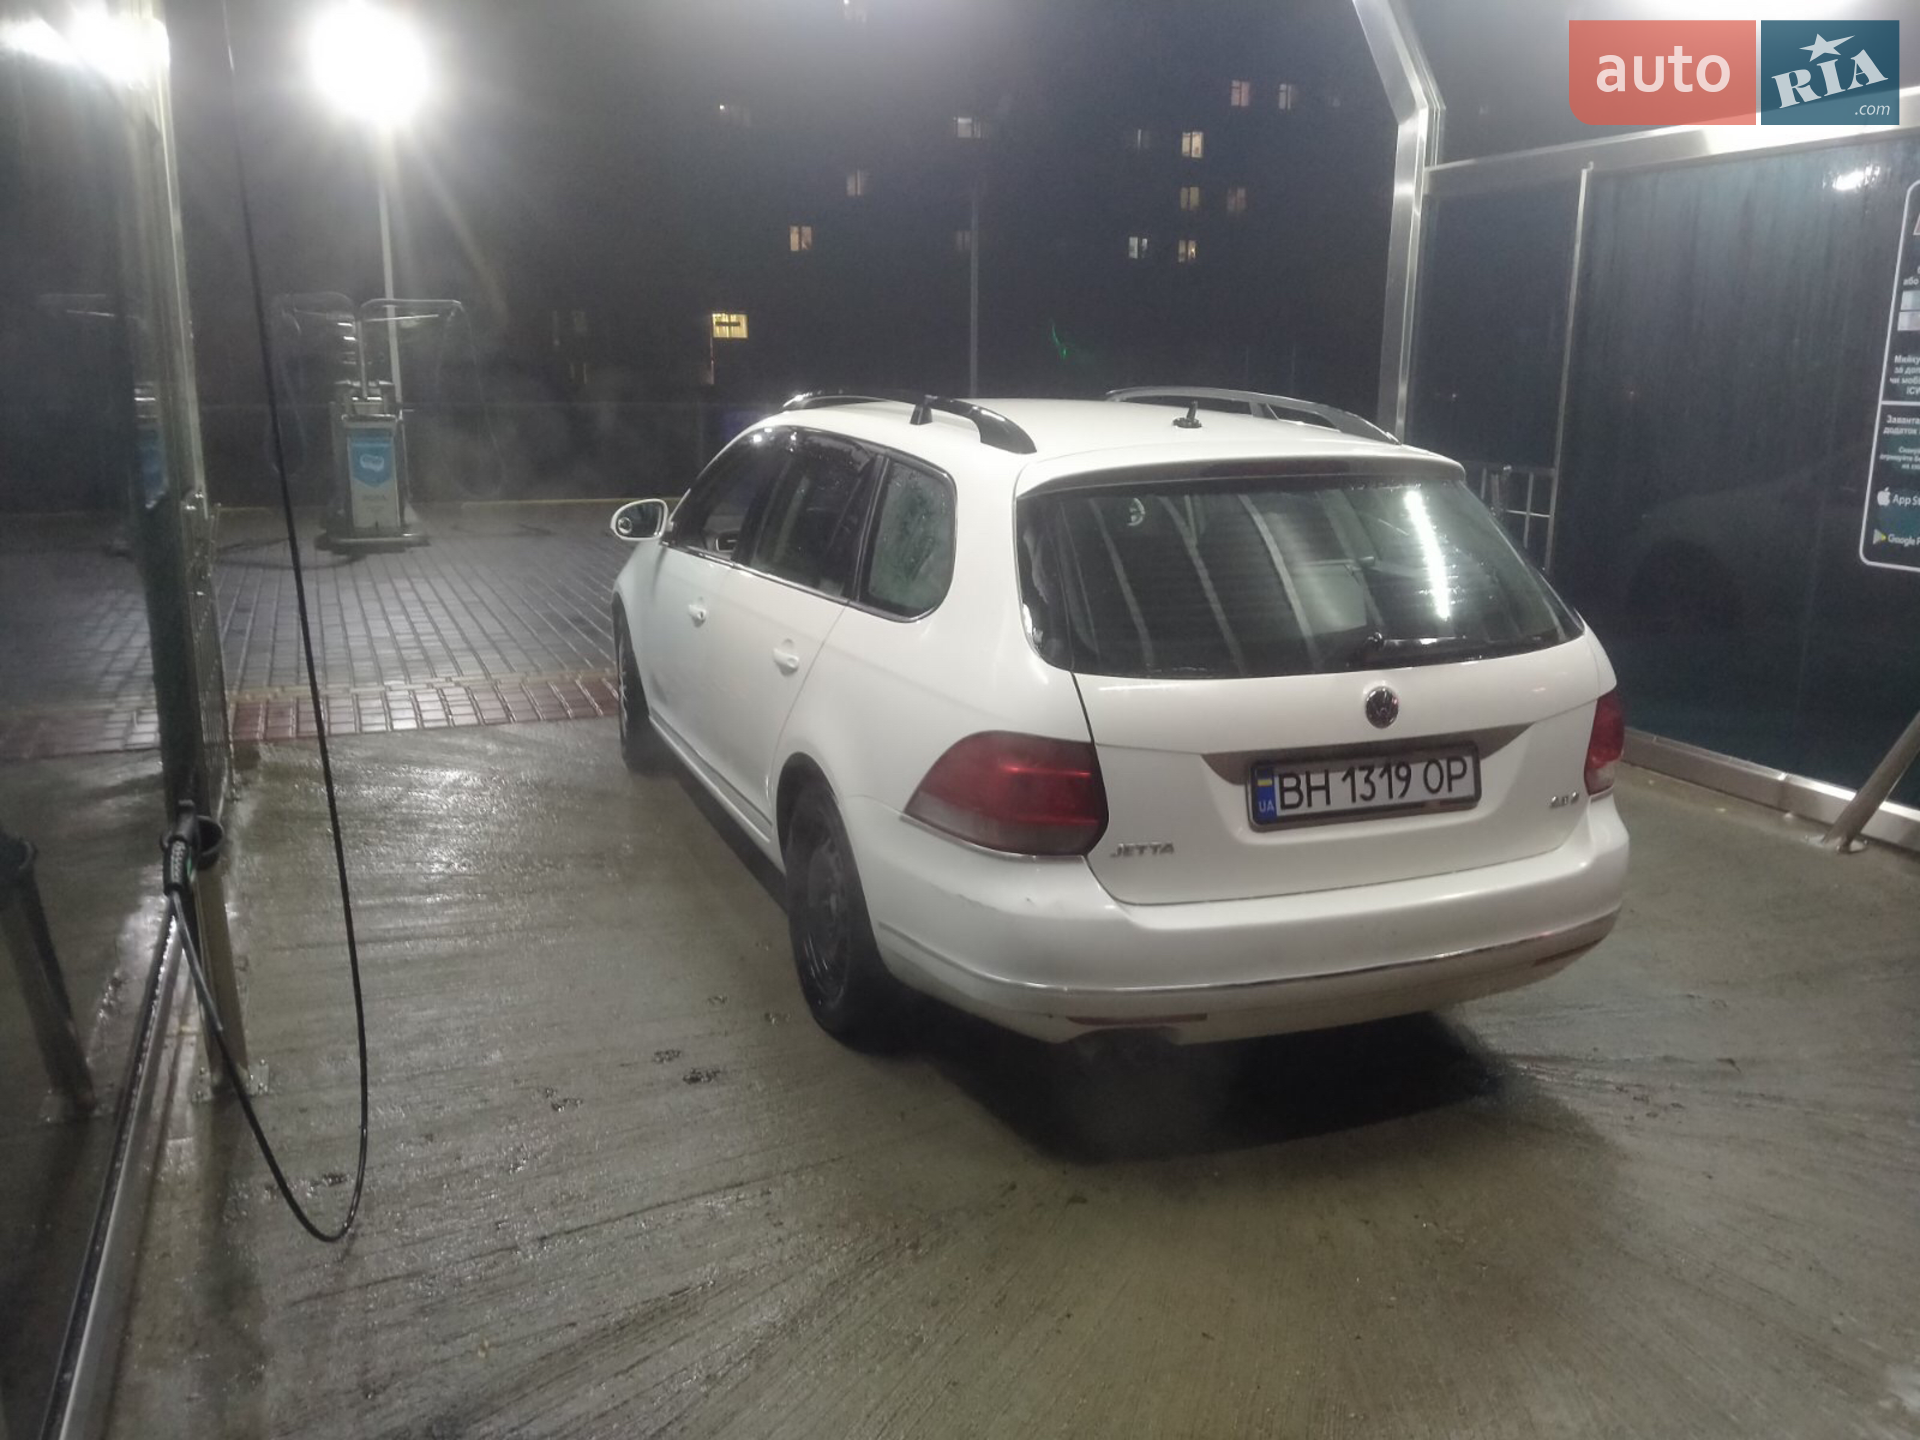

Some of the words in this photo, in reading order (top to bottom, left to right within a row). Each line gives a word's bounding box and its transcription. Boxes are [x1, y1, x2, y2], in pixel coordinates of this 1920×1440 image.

[1892, 494, 1911, 507] App
[1888, 533, 1915, 547] Google
[1278, 769, 1331, 810] BH
[1341, 763, 1412, 803] 1319
[1423, 756, 1467, 794] OP
[1258, 801, 1275, 813] UA
[1110, 842, 1174, 858] JETTA
